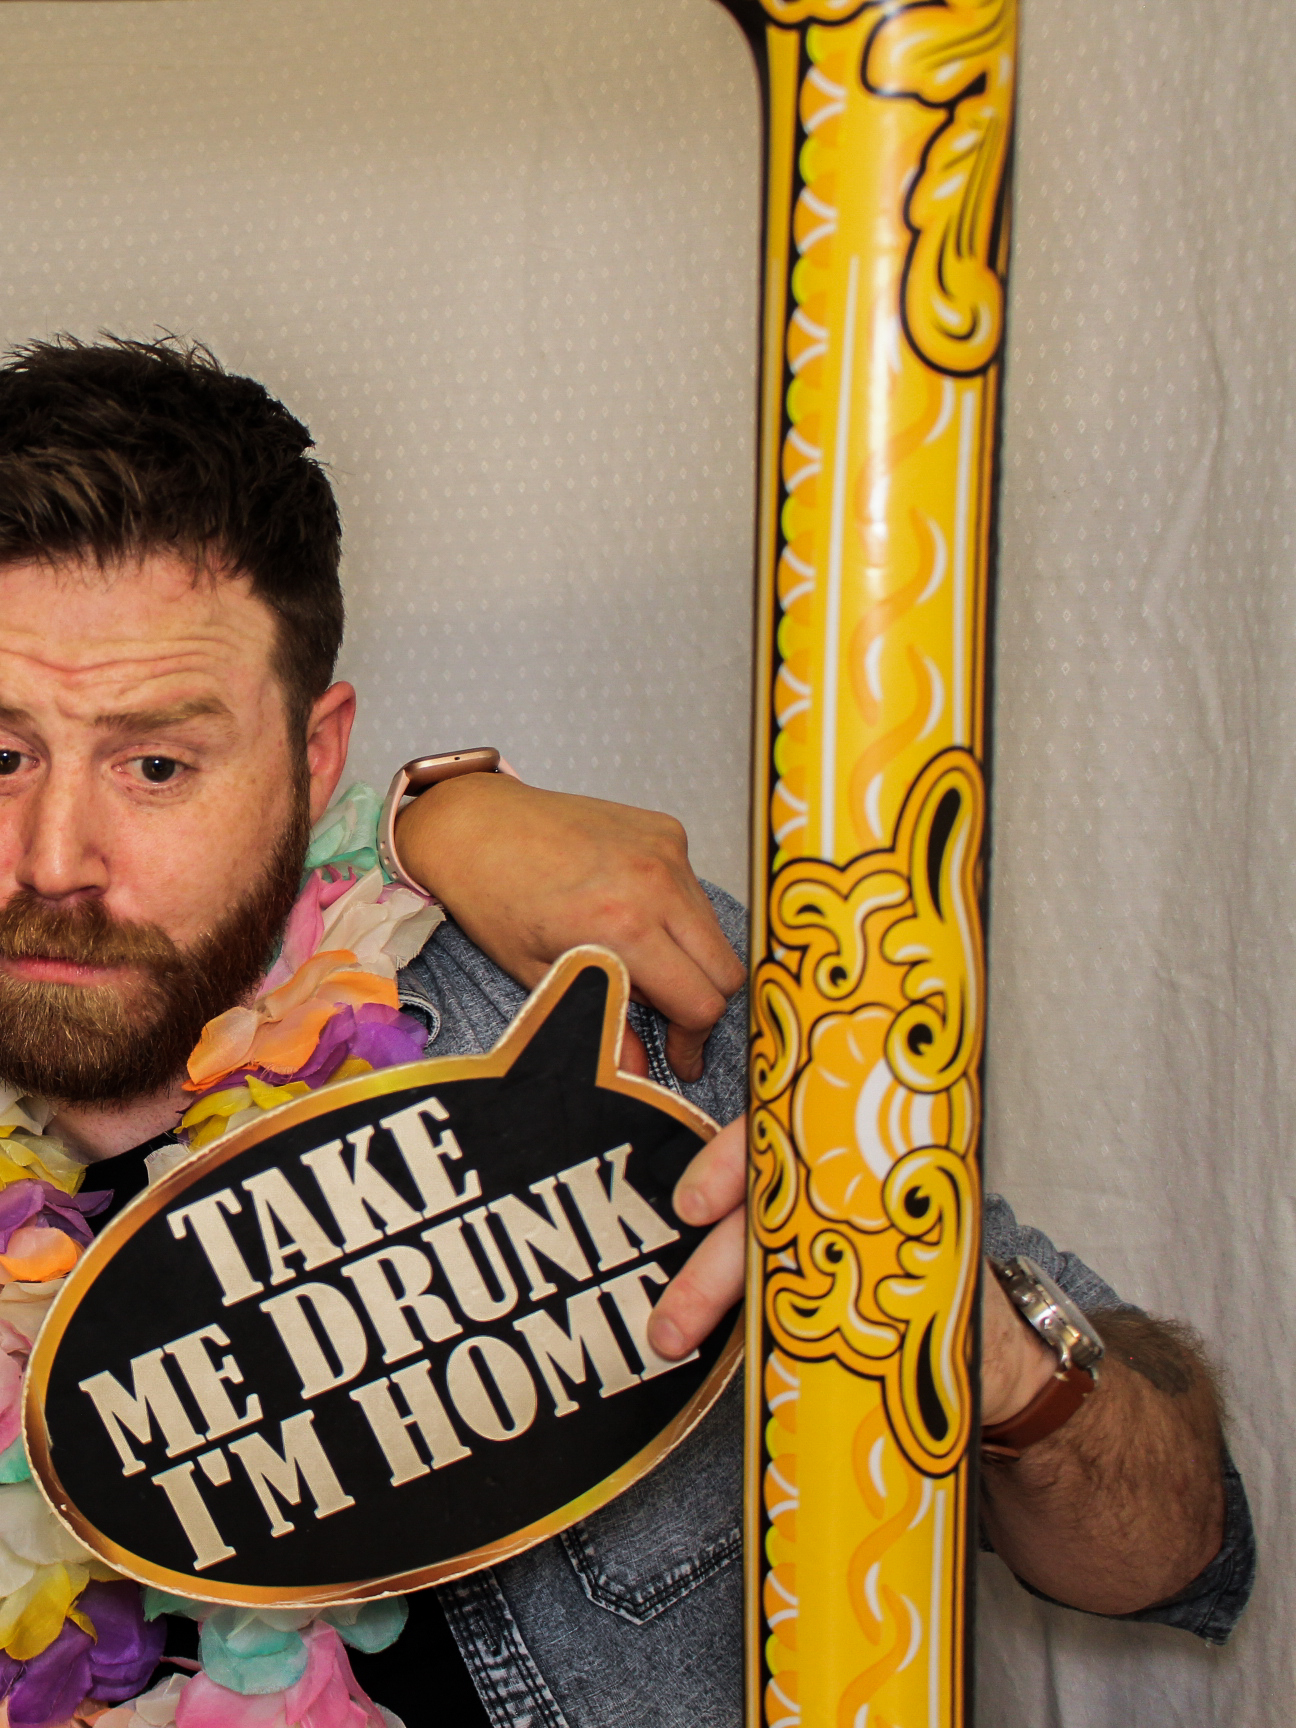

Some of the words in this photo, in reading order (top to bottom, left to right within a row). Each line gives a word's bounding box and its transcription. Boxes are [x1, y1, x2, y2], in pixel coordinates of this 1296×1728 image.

[77, 1323, 264, 1476] ME
[258, 1142, 681, 1400] DRUNK
[166, 1096, 482, 1307] TAKE
[150, 1409, 356, 1572] I'M
[348, 1261, 701, 1487] HOME
